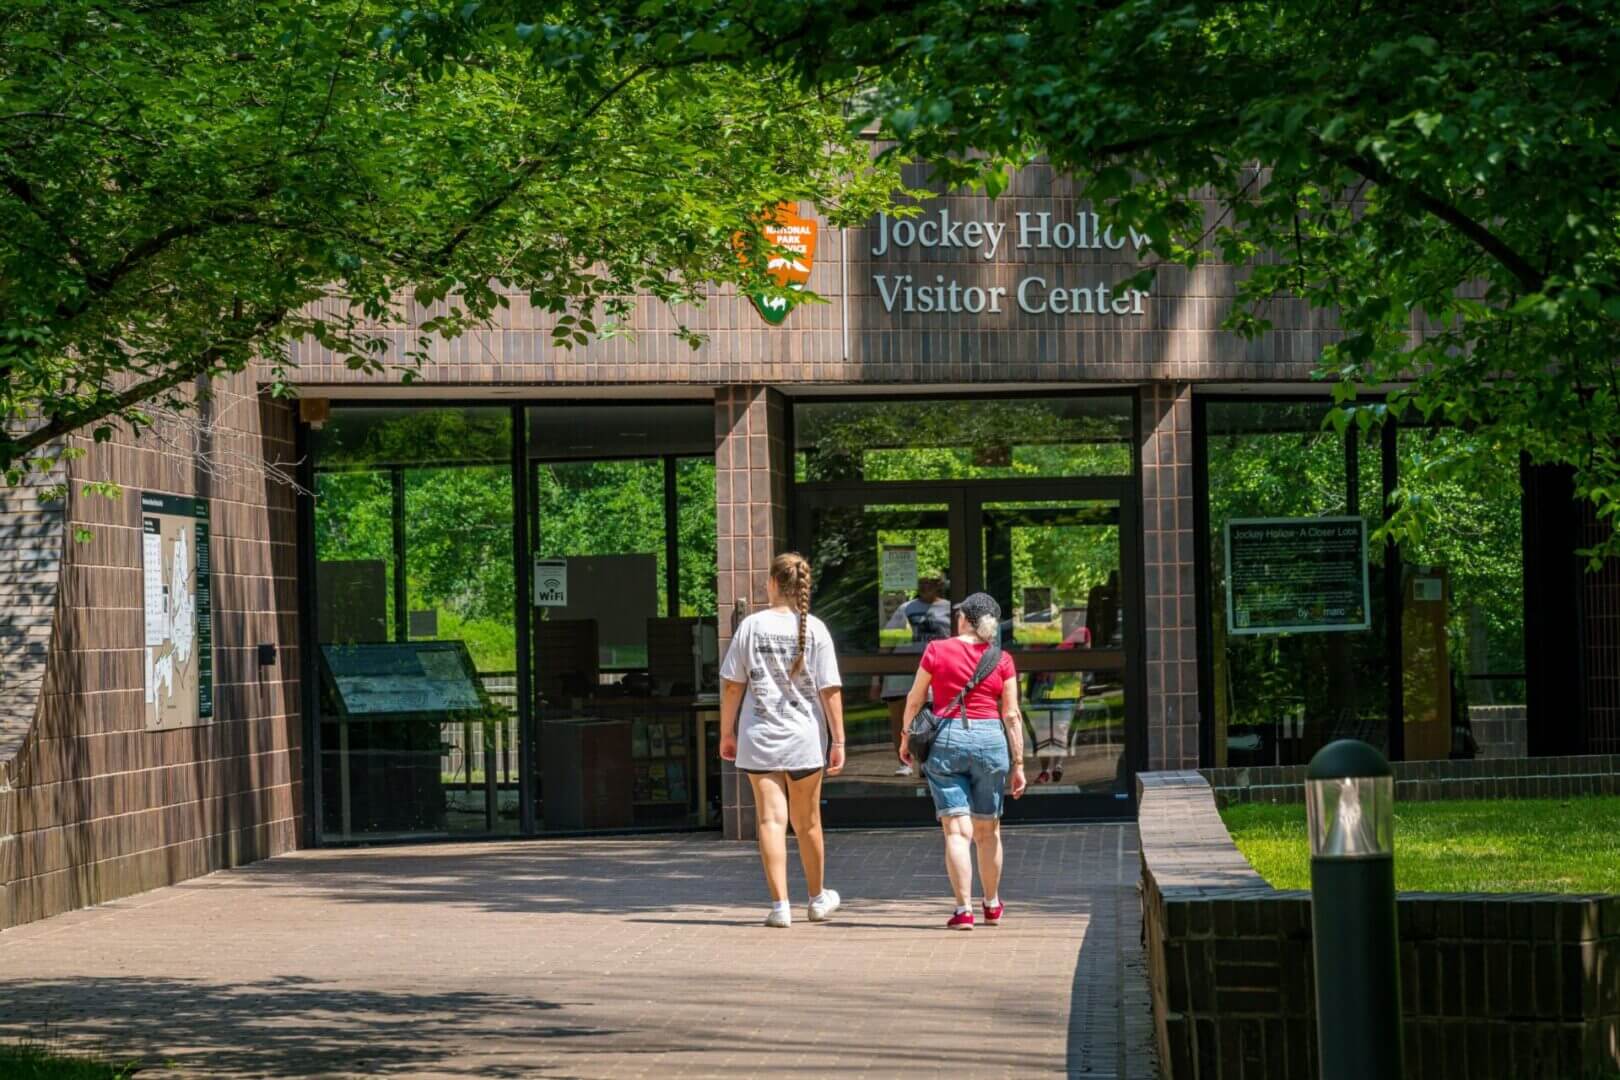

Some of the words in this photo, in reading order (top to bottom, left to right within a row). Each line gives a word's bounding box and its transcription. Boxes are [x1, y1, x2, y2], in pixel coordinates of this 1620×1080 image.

[776, 235, 801, 244] PARK
[872, 209, 1006, 260] Jockey
[872, 274, 1006, 314] Visitor
[1017, 276, 1149, 315] Center
[539, 590, 564, 601] WiFi
